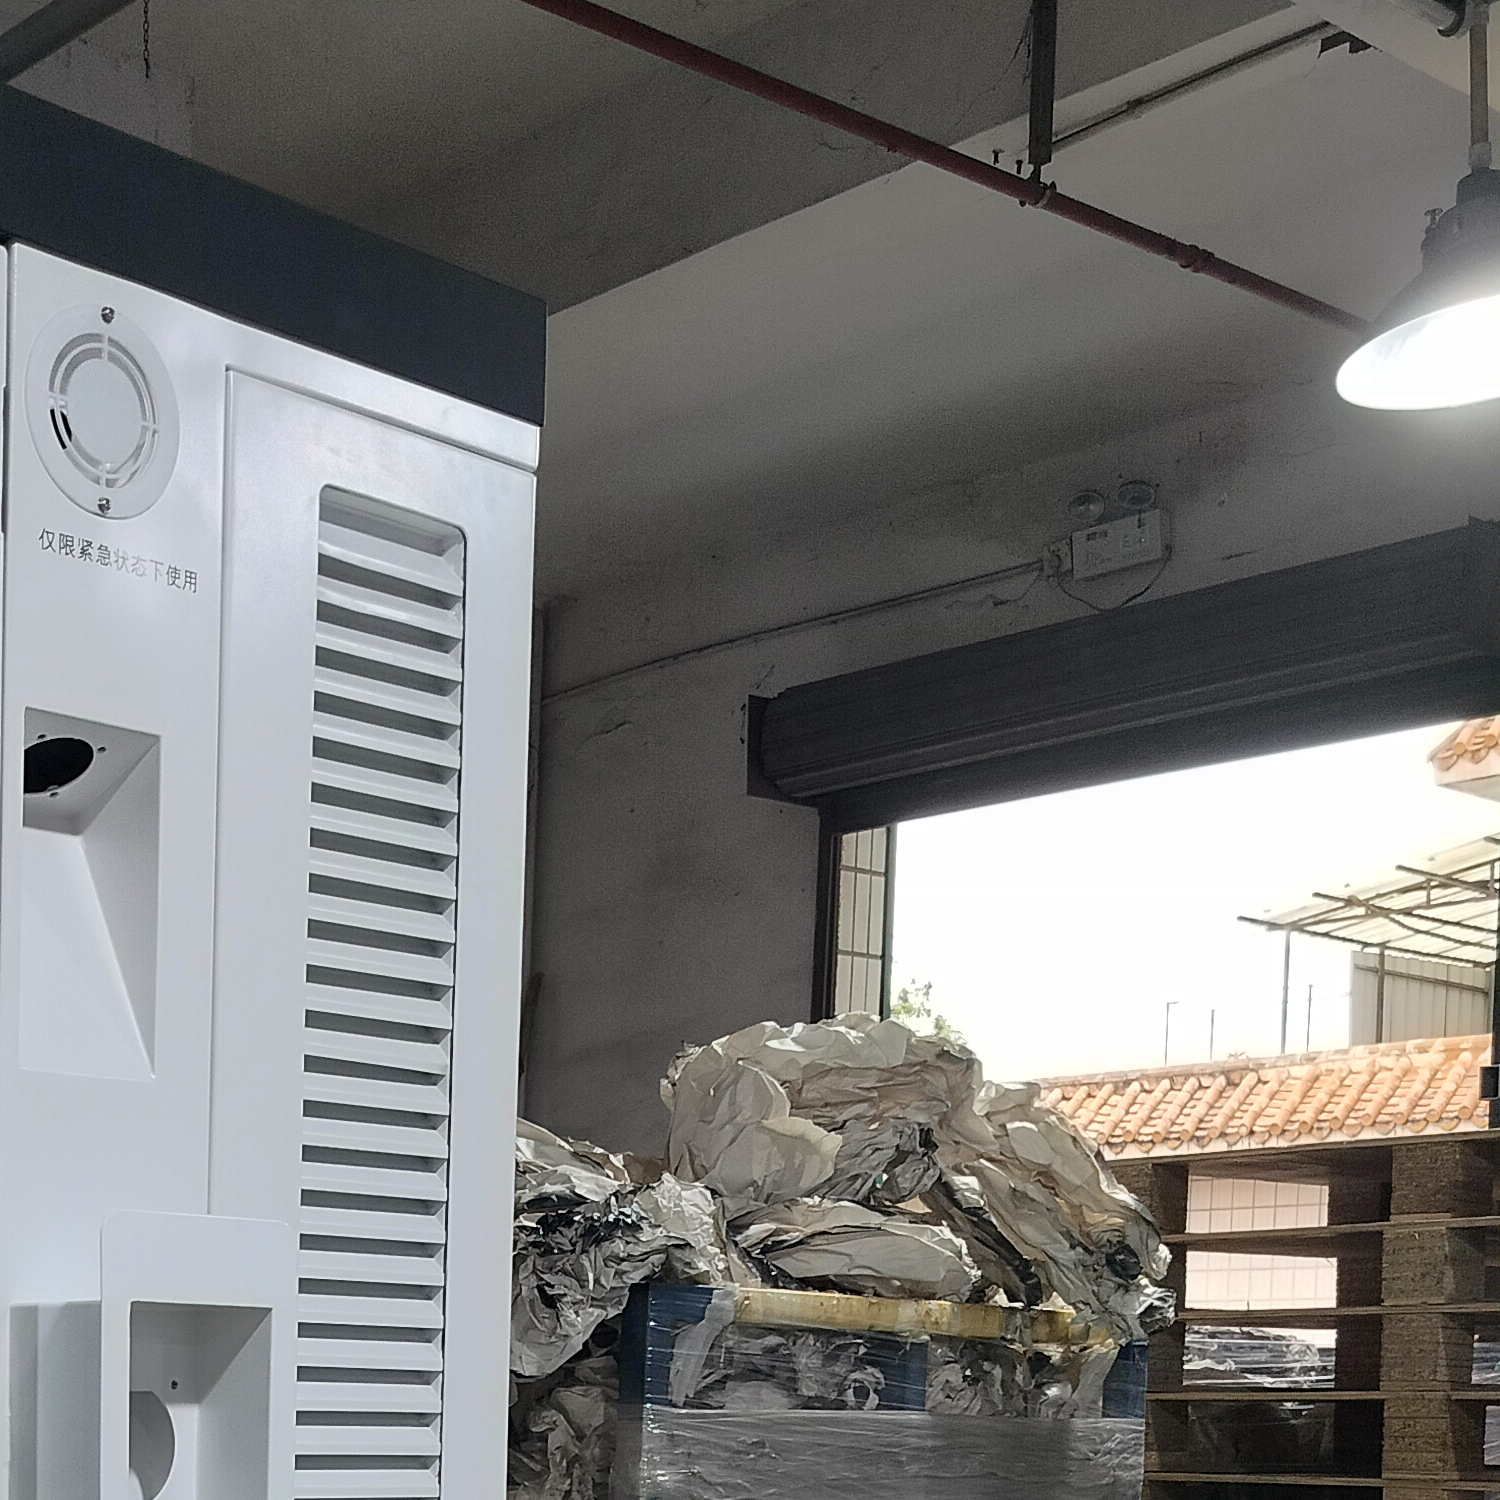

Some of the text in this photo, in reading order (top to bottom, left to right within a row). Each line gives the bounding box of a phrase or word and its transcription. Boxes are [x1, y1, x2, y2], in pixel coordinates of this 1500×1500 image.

[38, 528, 198, 594] 仅限紧急状态下使用
